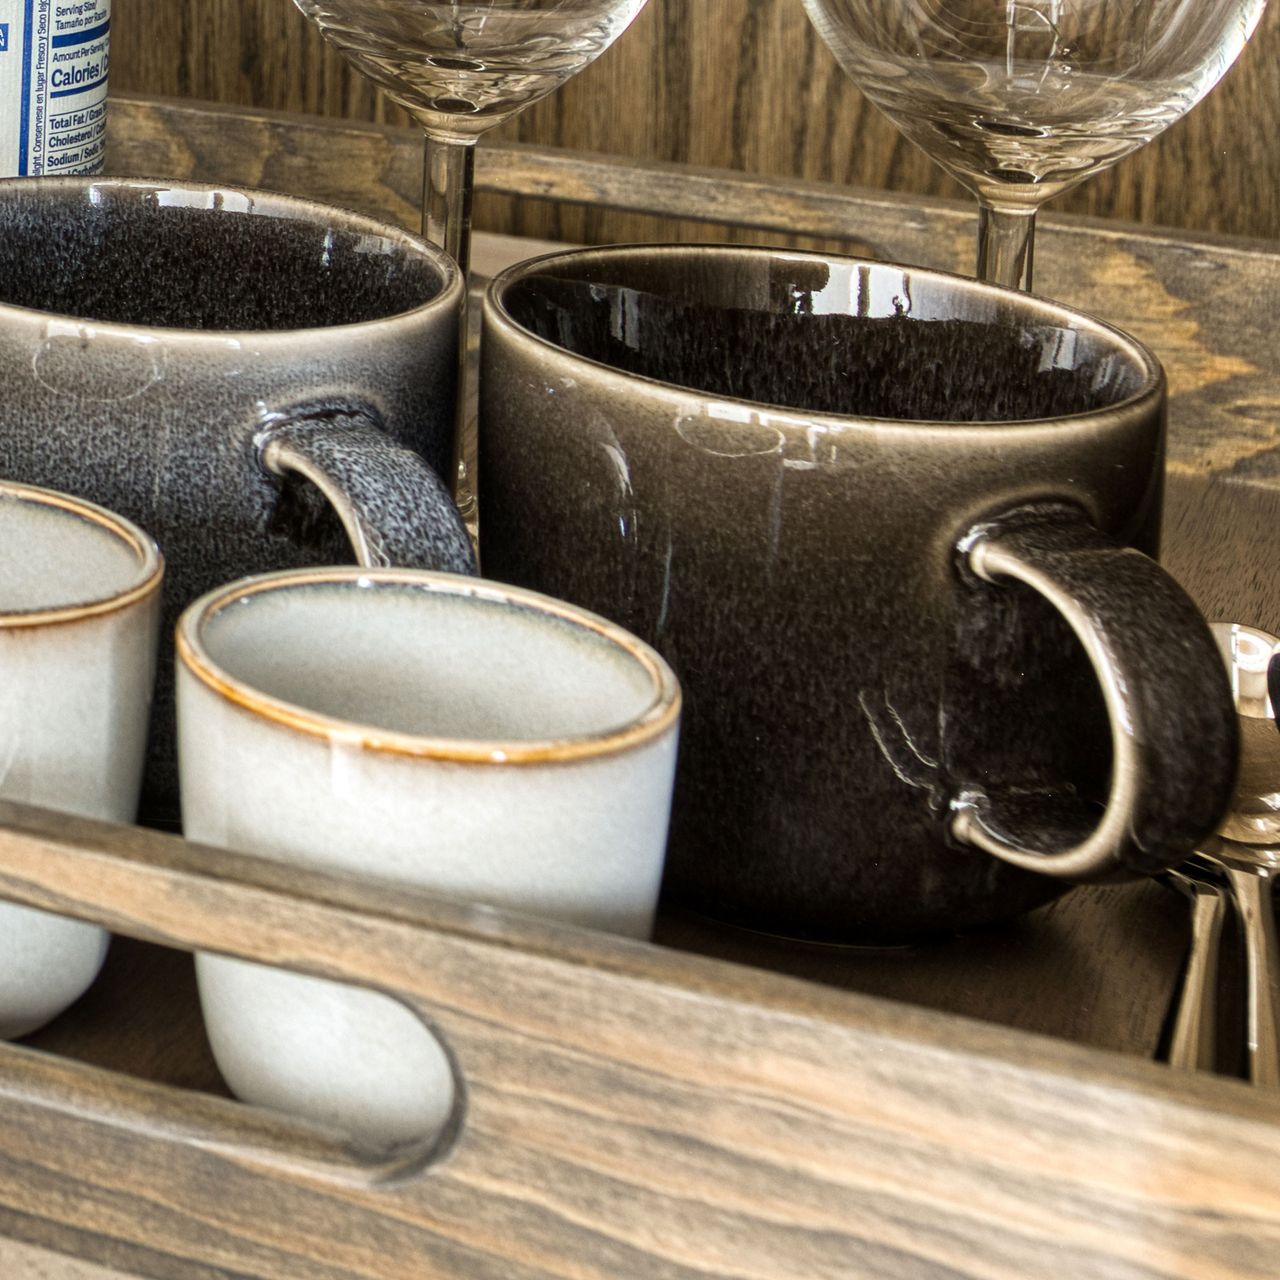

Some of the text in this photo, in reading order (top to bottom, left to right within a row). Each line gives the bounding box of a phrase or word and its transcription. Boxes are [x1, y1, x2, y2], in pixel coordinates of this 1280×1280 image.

[56, 3, 83, 17] Serving
[37, 13, 47, 34] Seco
[55, 15, 83, 30] Tamaño
[36, 42, 46, 69] Fresco
[53, 50, 80, 63] Amount
[35, 72, 46, 92] lugar
[51, 61, 99, 88] Calories
[37, 93, 44, 103] en
[33, 106, 43, 152] Conservese
[49, 115, 72, 130] Total
[73, 114, 85, 126] Fat
[48, 127, 93, 148] Cholesterol
[47, 153, 80, 167] Sodium
